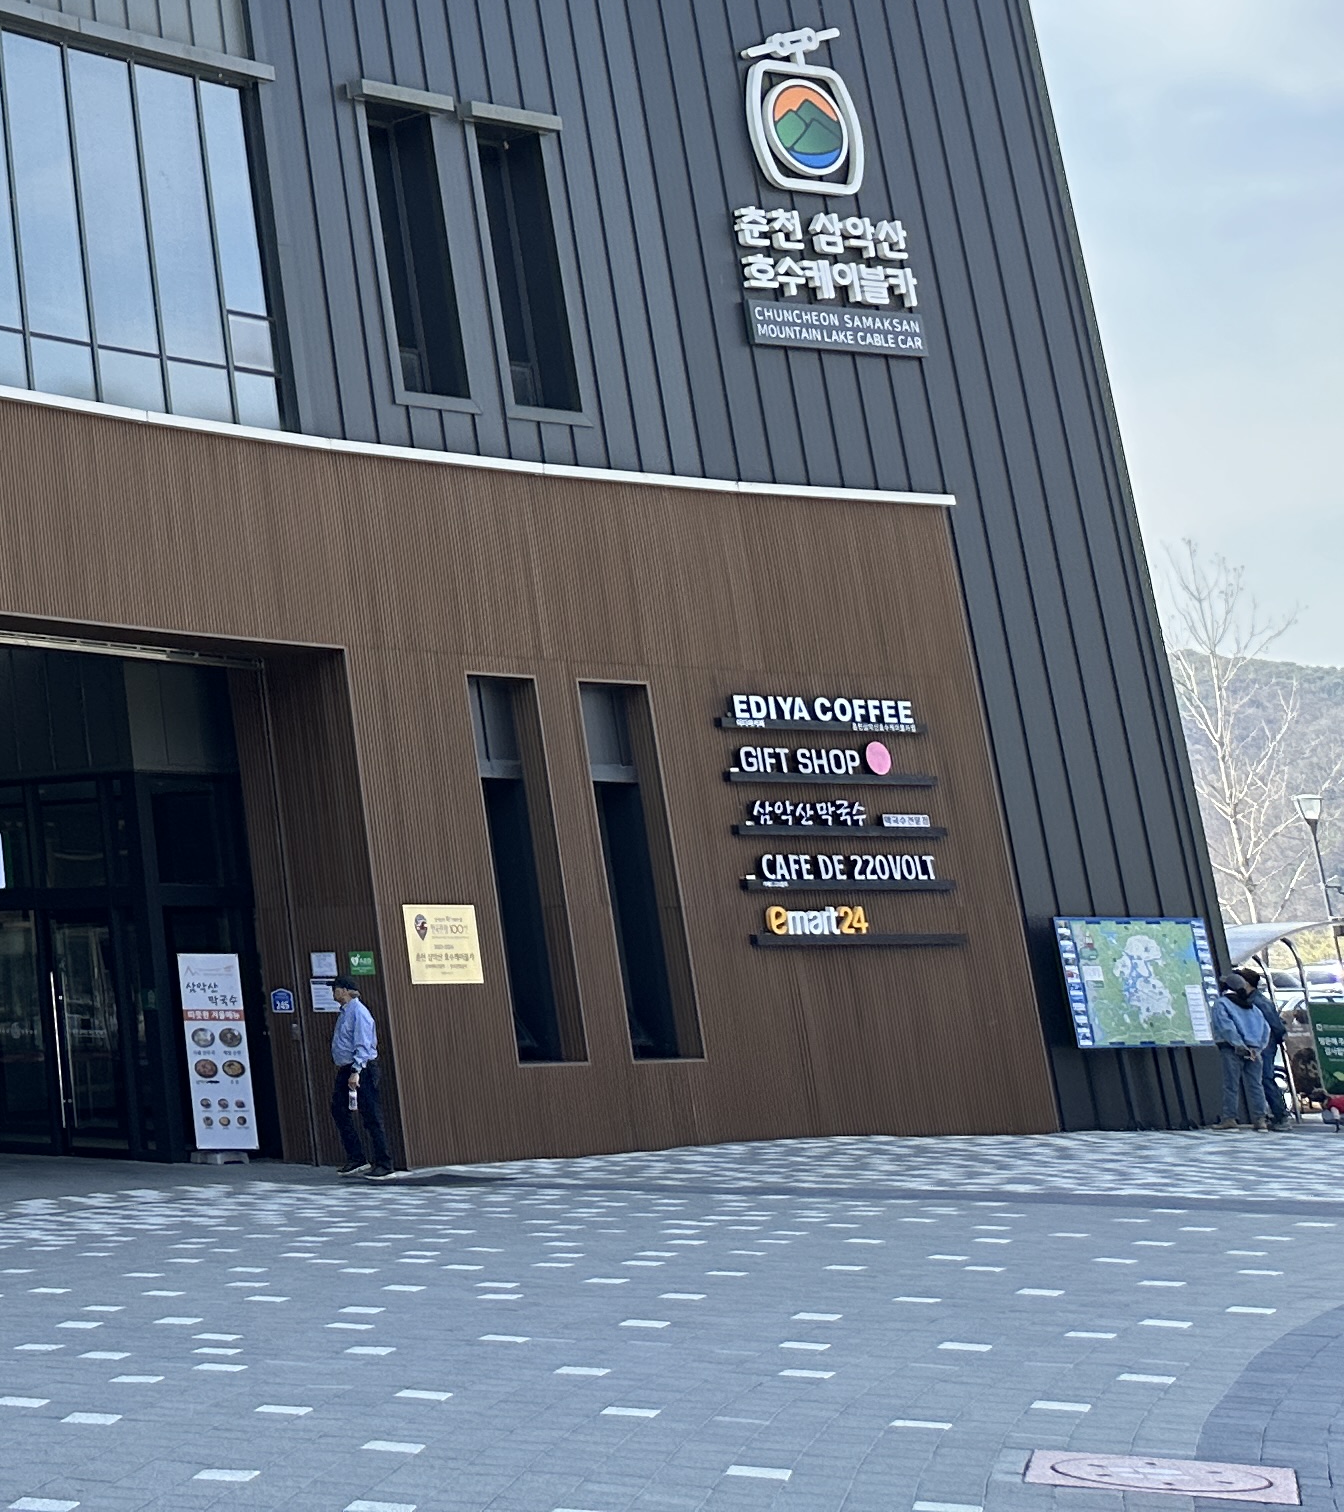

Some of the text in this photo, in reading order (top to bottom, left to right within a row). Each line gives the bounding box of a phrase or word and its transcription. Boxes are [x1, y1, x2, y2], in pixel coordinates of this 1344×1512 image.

[733, 205, 909, 261] 춘천 삼악산
[740, 253, 918, 308] 호수케이블카
[754, 306, 920, 334] CHUNCHEON SAMAKSAN
[756, 323, 923, 350] MOUNTAIN LAKE CABLE CAR
[732, 694, 915, 724] EDIYA COFFEE
[739, 746, 861, 776] GIFT SHOP
[761, 854, 936, 881] CAFE DE 220VOLT
[765, 905, 869, 935] emart24
